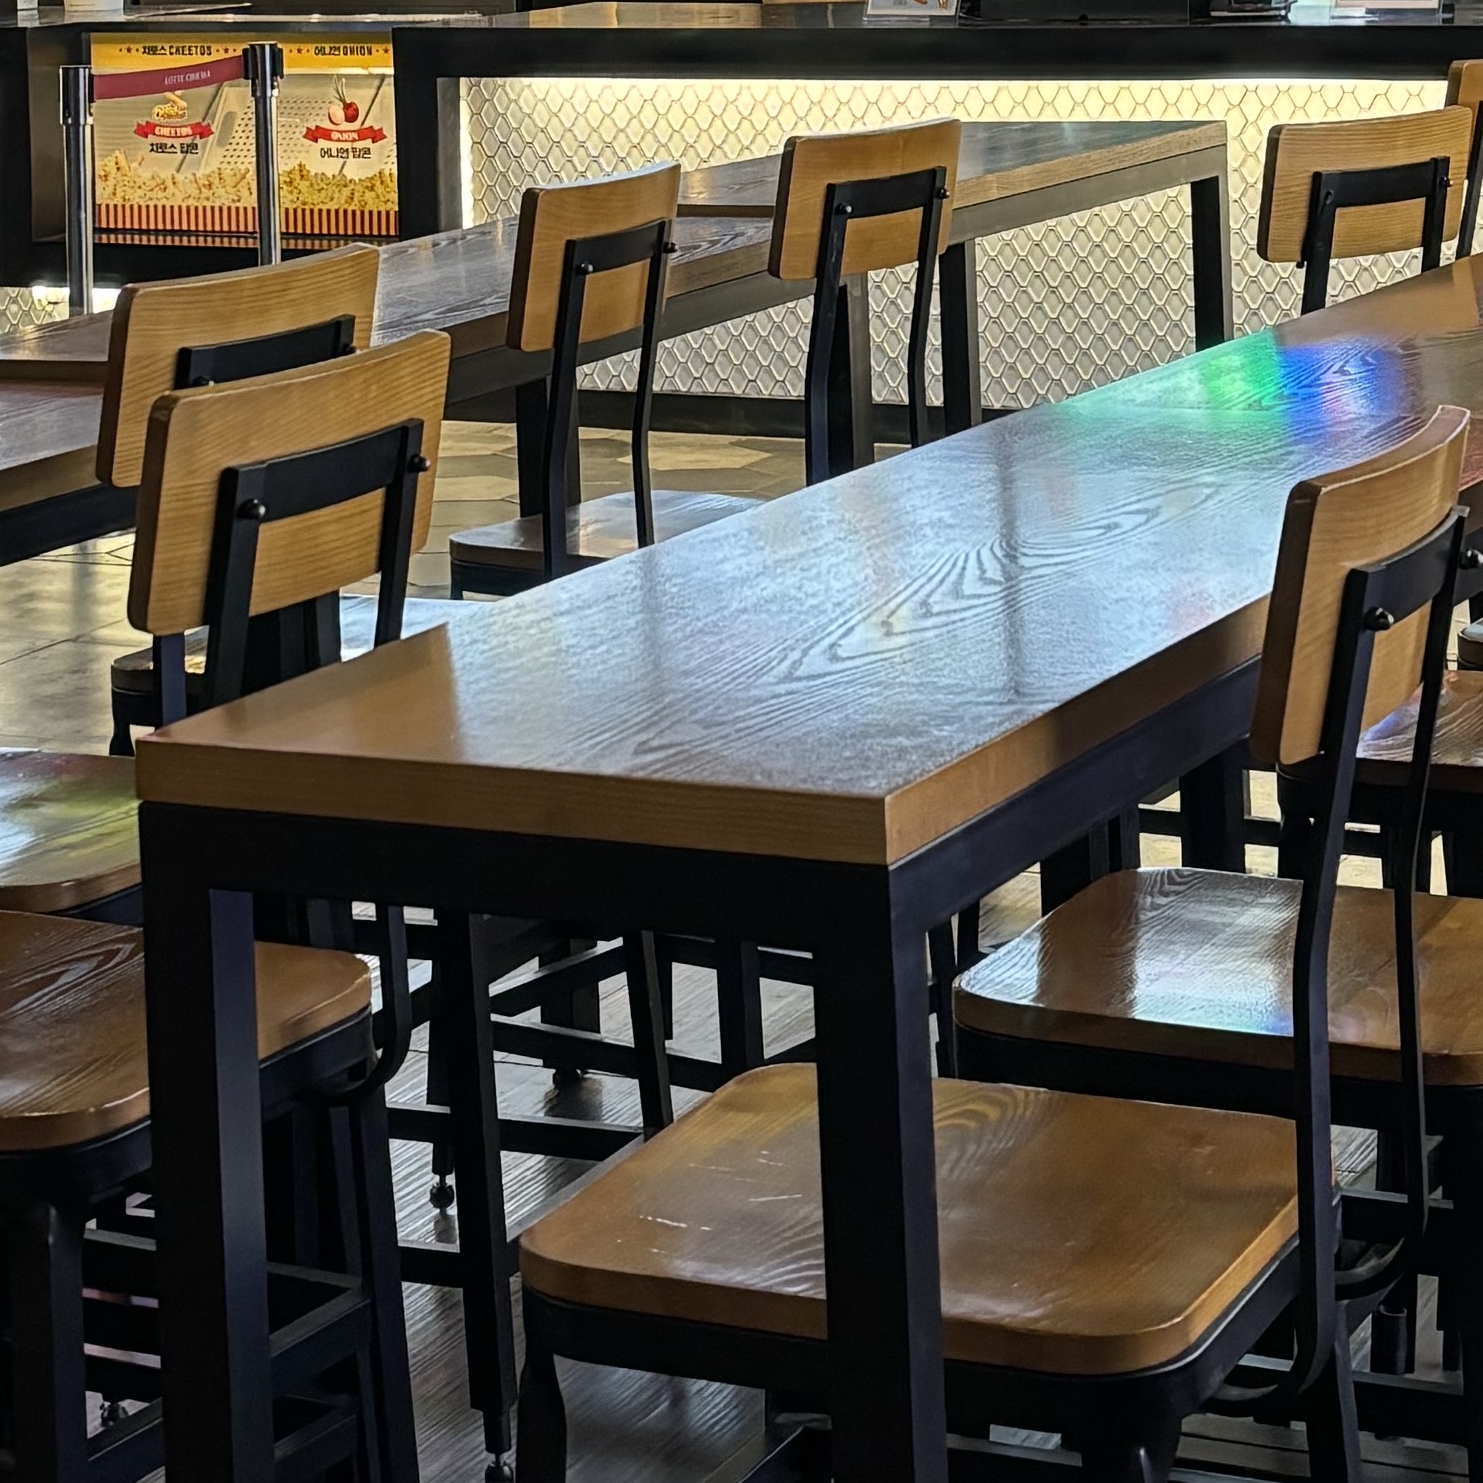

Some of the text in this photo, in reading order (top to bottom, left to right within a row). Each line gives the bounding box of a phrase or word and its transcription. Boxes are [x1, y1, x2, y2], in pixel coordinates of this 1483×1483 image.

[169, 45, 212, 56] CHEETOS
[342, 45, 373, 56] ONION
[164, 75, 185, 85] LOTTE
[154, 126, 193, 136] CHEETOS
[319, 147, 349, 159] 어니언
